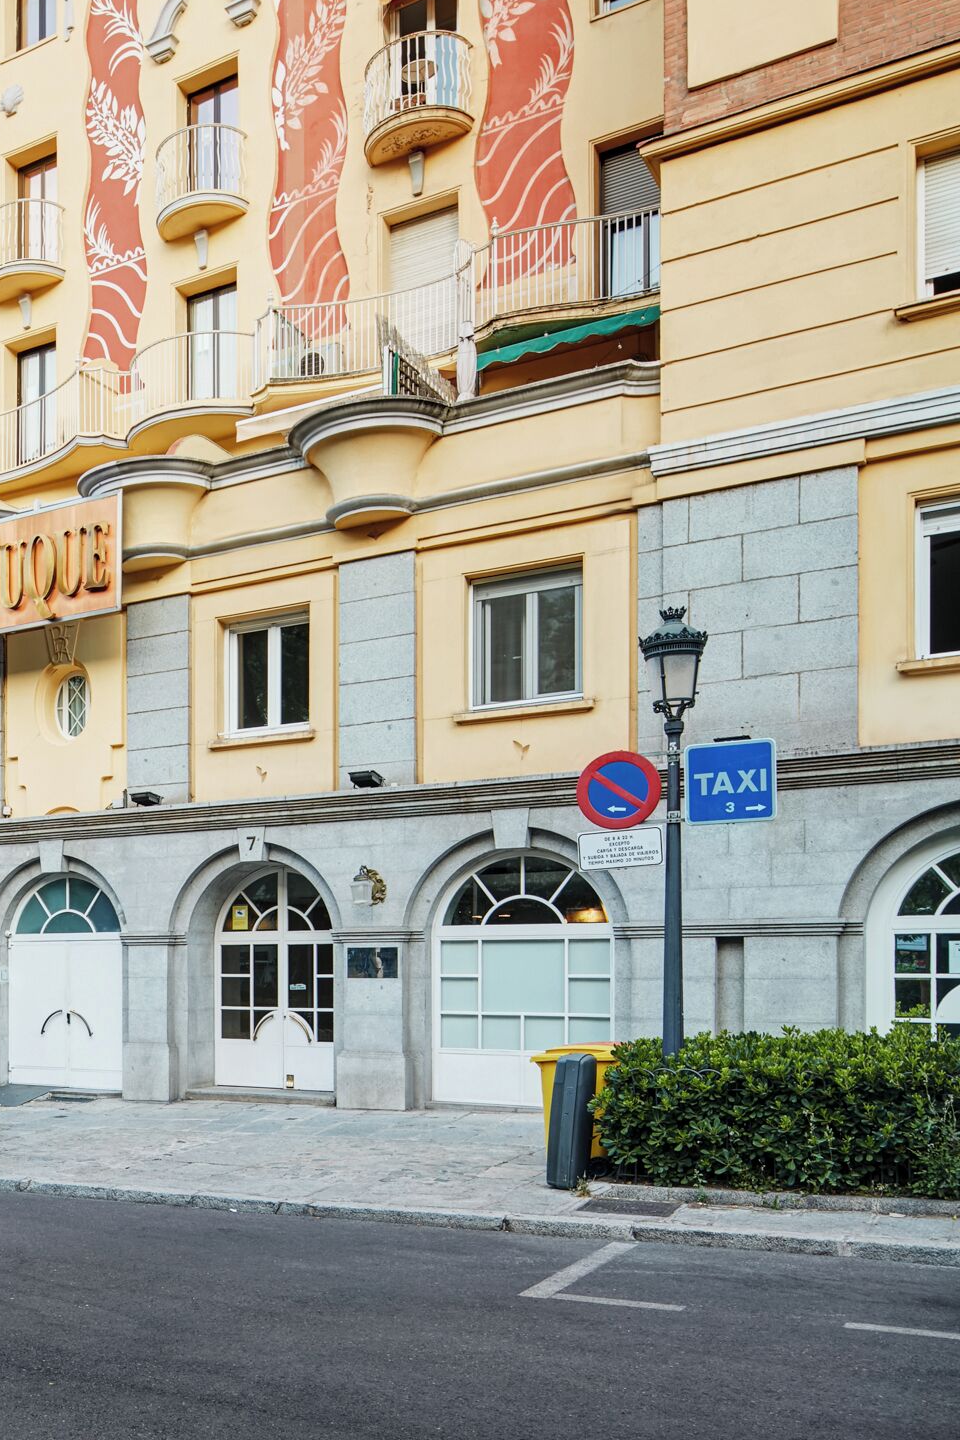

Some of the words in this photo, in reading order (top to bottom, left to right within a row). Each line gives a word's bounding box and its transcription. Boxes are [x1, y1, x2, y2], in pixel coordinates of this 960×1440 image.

[693, 768, 767, 796] TAXI
[725, 801, 735, 813] 3
[246, 836, 256, 851] 7
